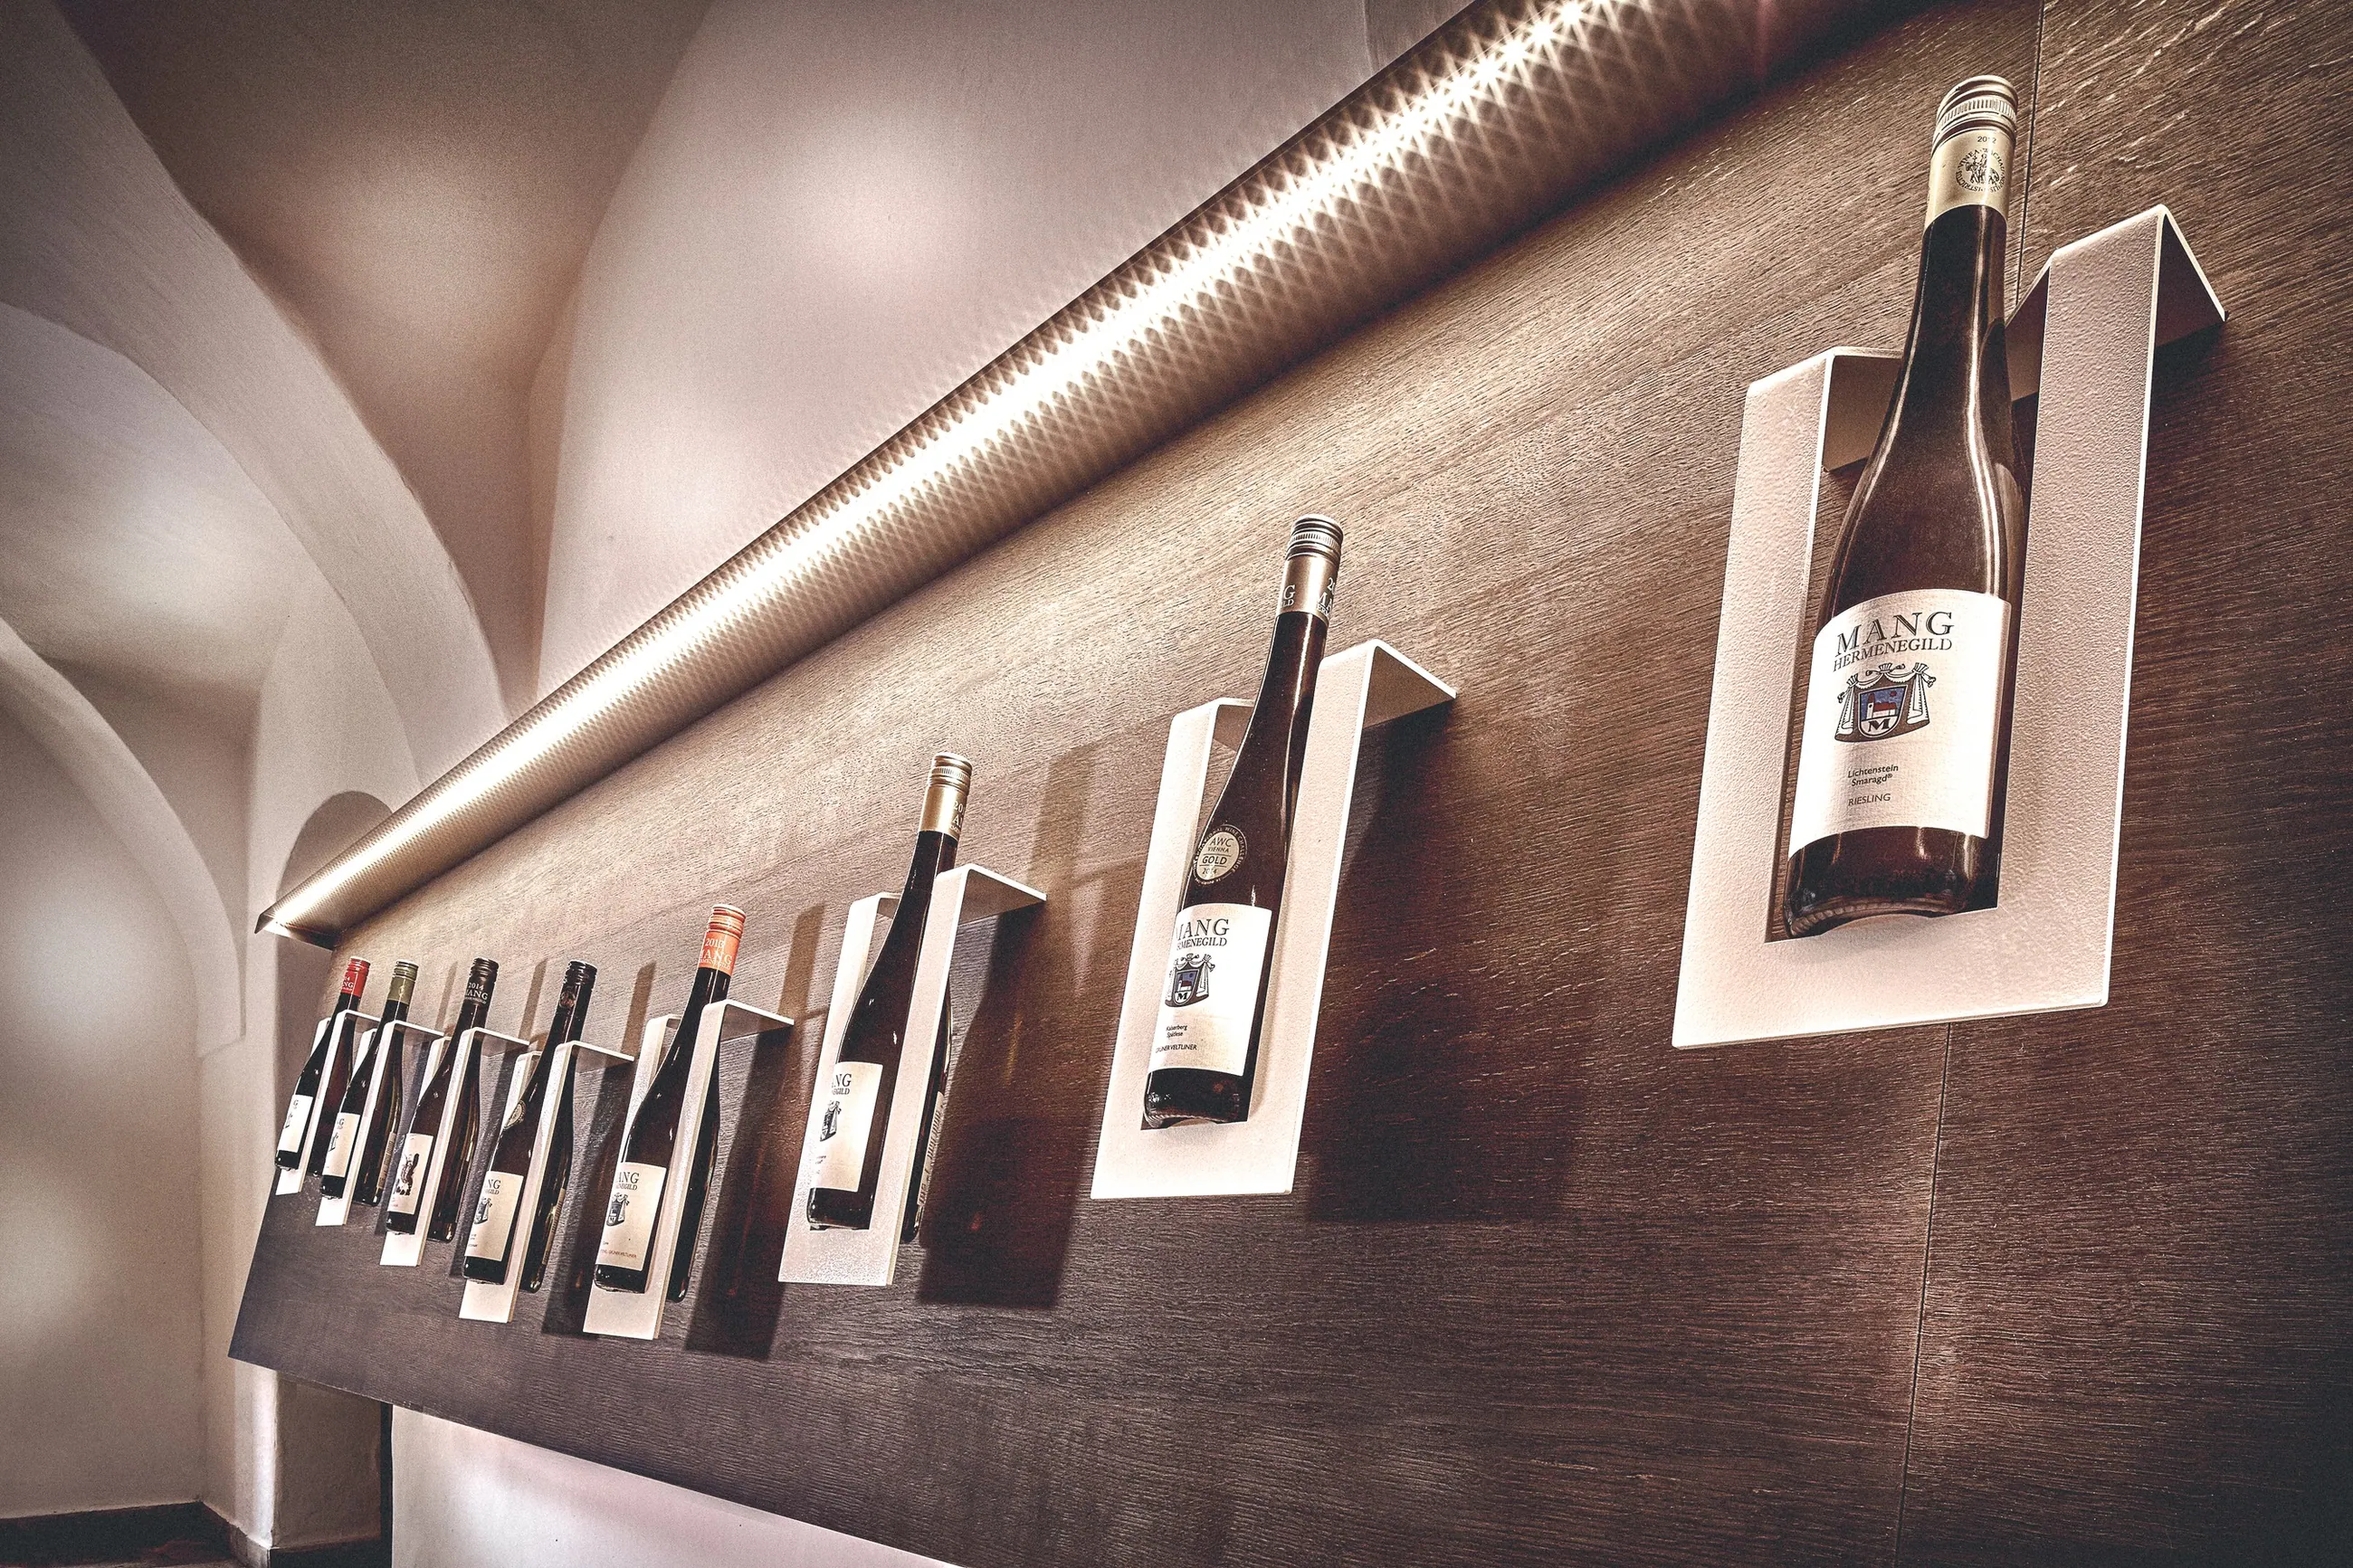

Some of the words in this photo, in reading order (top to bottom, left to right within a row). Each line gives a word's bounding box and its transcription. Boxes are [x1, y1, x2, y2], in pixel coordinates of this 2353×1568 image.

[1977, 136, 1996, 144] 202
[1958, 149, 1979, 168] VINEA
[1835, 612, 1954, 657] MANG
[1833, 638, 1953, 672] HERMENEGILD
[1868, 717, 1891, 732] M
[1848, 765, 1899, 778] Lichtenstein
[1848, 794, 1891, 806] RIESLING
[1209, 837, 1234, 848] AWC
[1202, 855, 1227, 865] GOLD
[468, 982, 484, 991] 2014
